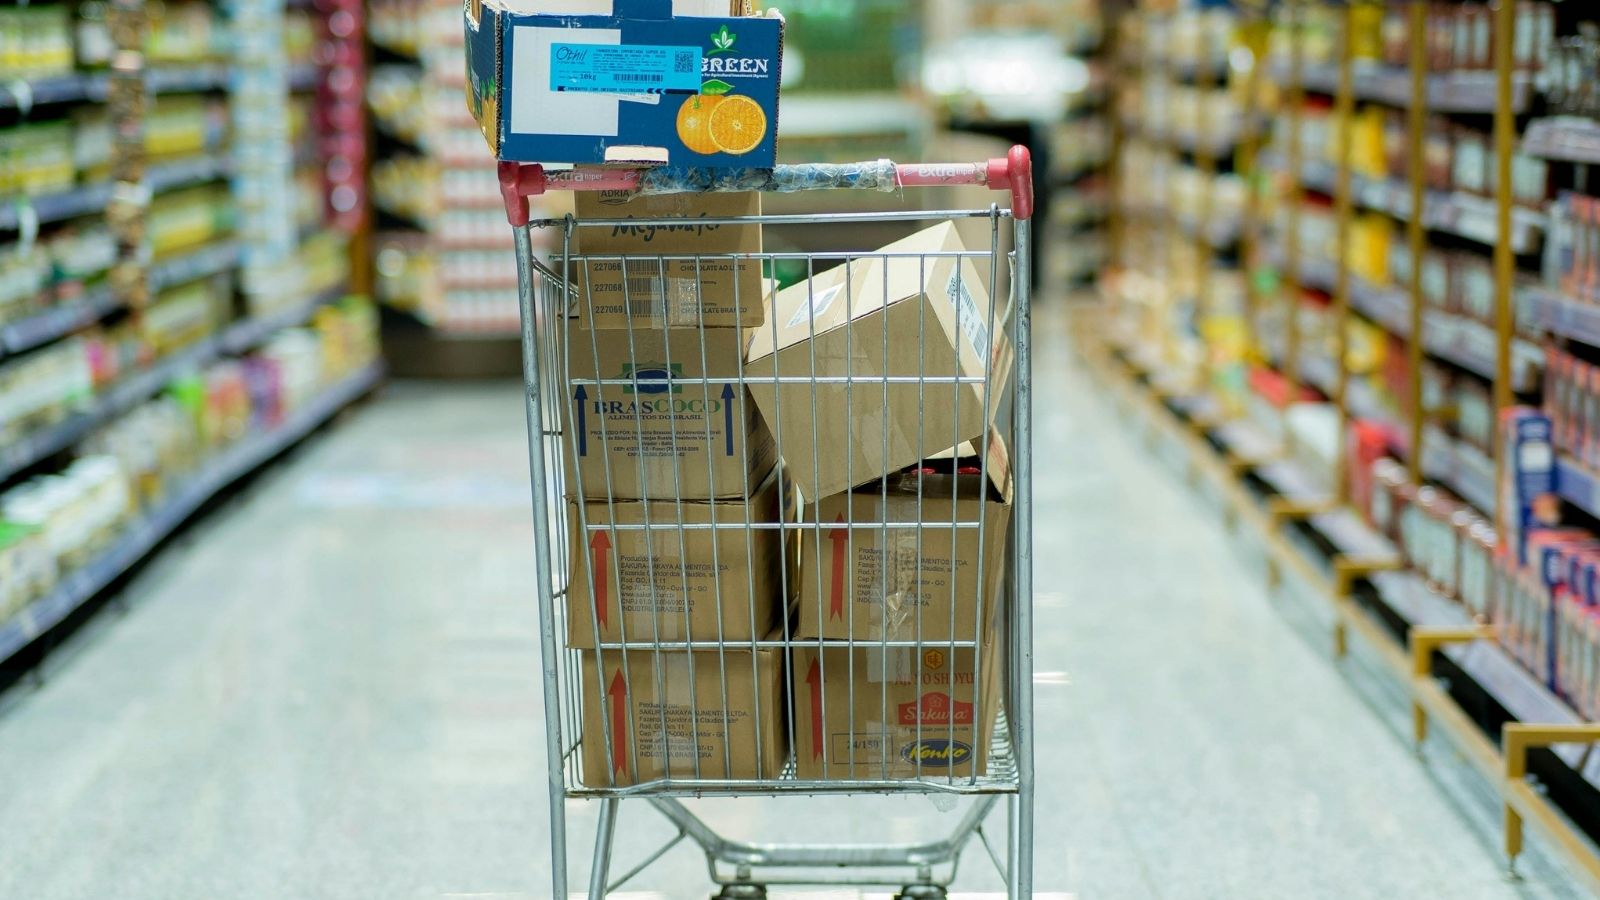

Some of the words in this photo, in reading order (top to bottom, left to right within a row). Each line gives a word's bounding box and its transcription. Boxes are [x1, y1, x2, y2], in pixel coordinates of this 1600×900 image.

[918, 165, 957, 177] extra
[600, 188, 630, 199] ADRIA
[680, 264, 718, 272] CHOOLATE
[719, 264, 728, 272] AO
[729, 264, 747, 272] LTE
[594, 398, 721, 415] BRASCOCO
[620, 562, 673, 570] SAKURA-AKAYA
[675, 563, 711, 571] ALMENTOS
[639, 709, 692, 717] SAKUR-NAKAYA
